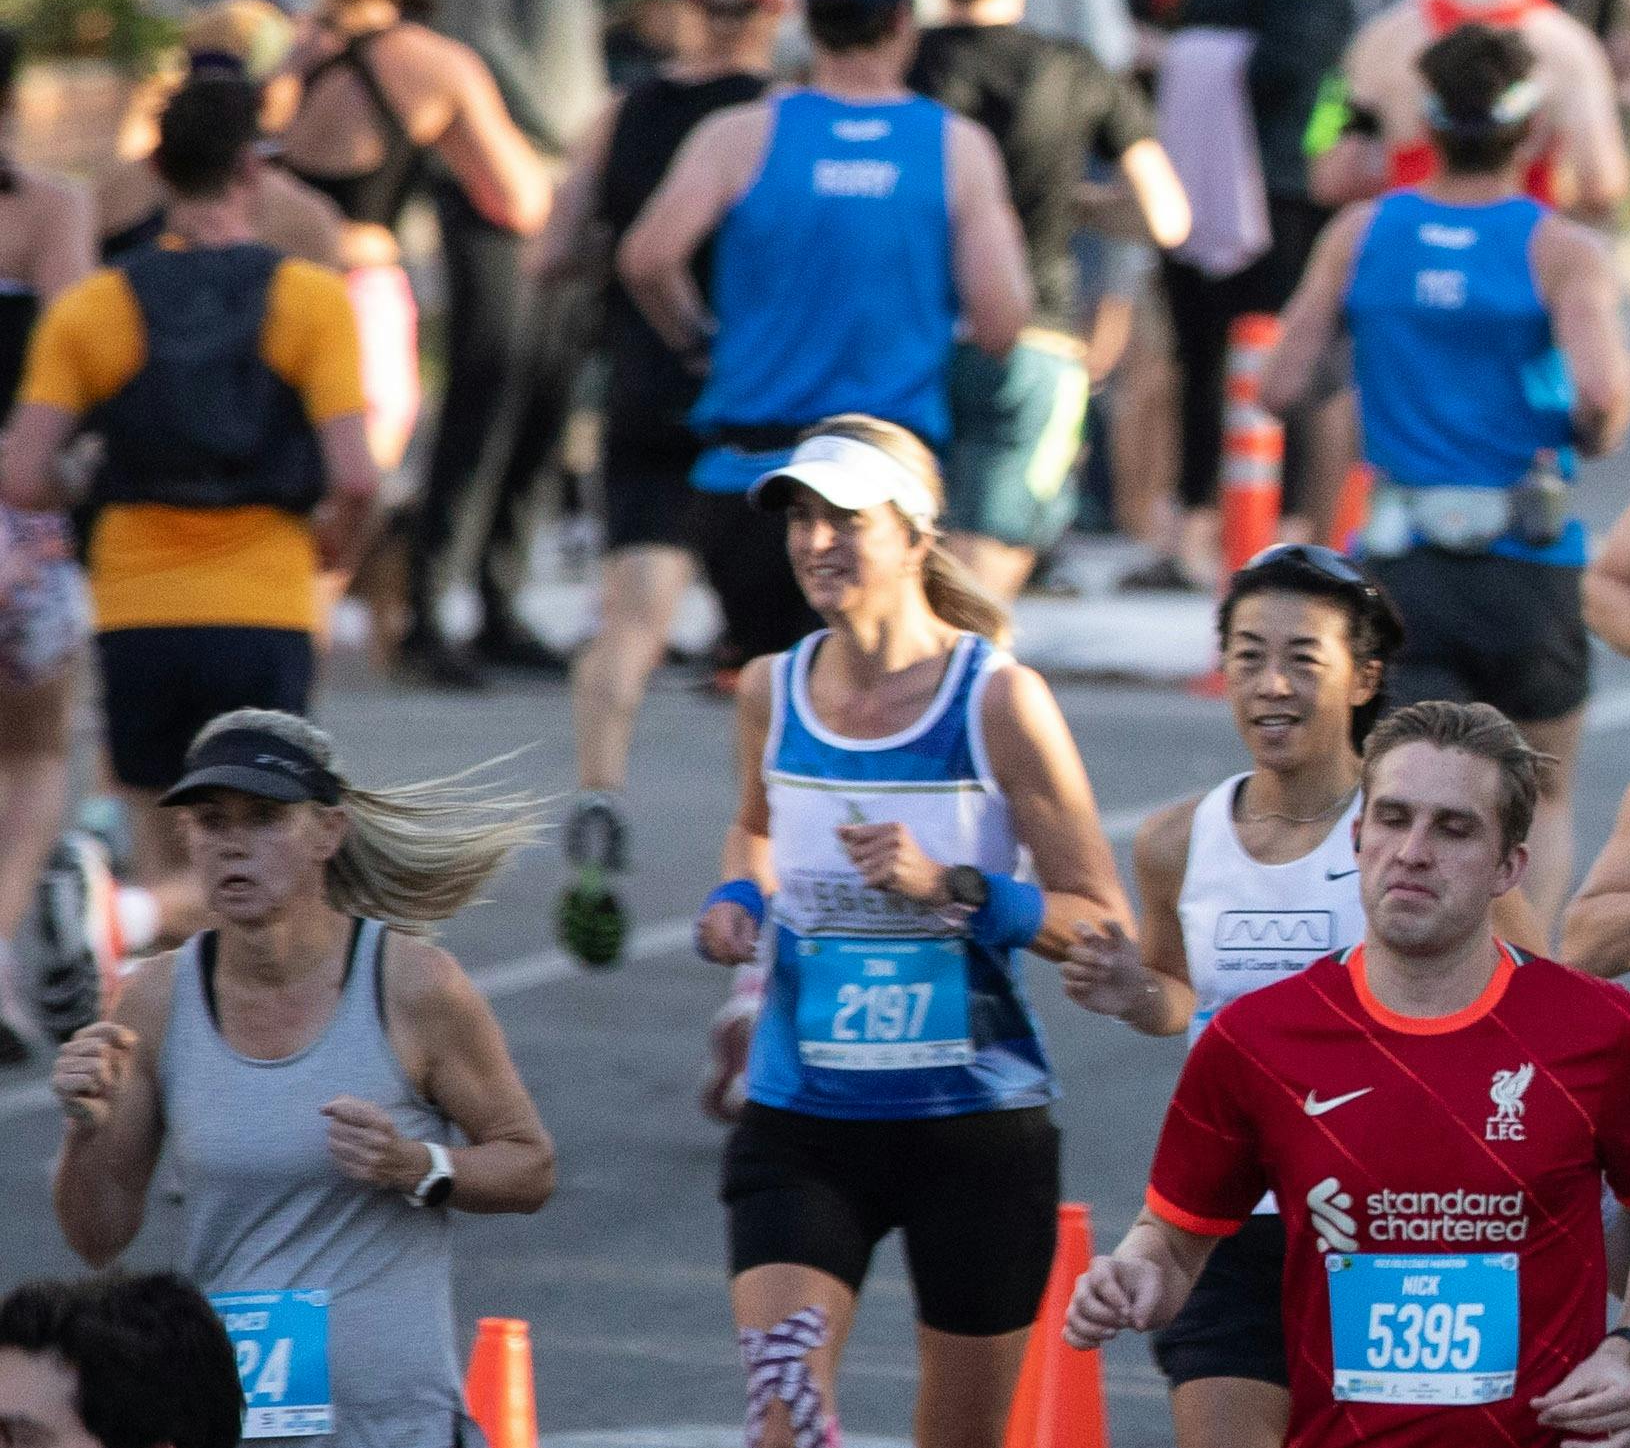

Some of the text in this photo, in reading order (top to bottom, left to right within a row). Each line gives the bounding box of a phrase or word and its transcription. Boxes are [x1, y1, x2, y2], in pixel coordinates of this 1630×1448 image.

[1366, 1188, 1524, 1216] standard
[1368, 1215, 1530, 1242] chartered
[1402, 1275, 1441, 1296] NICK
[1366, 1303, 1486, 1371] 5395
